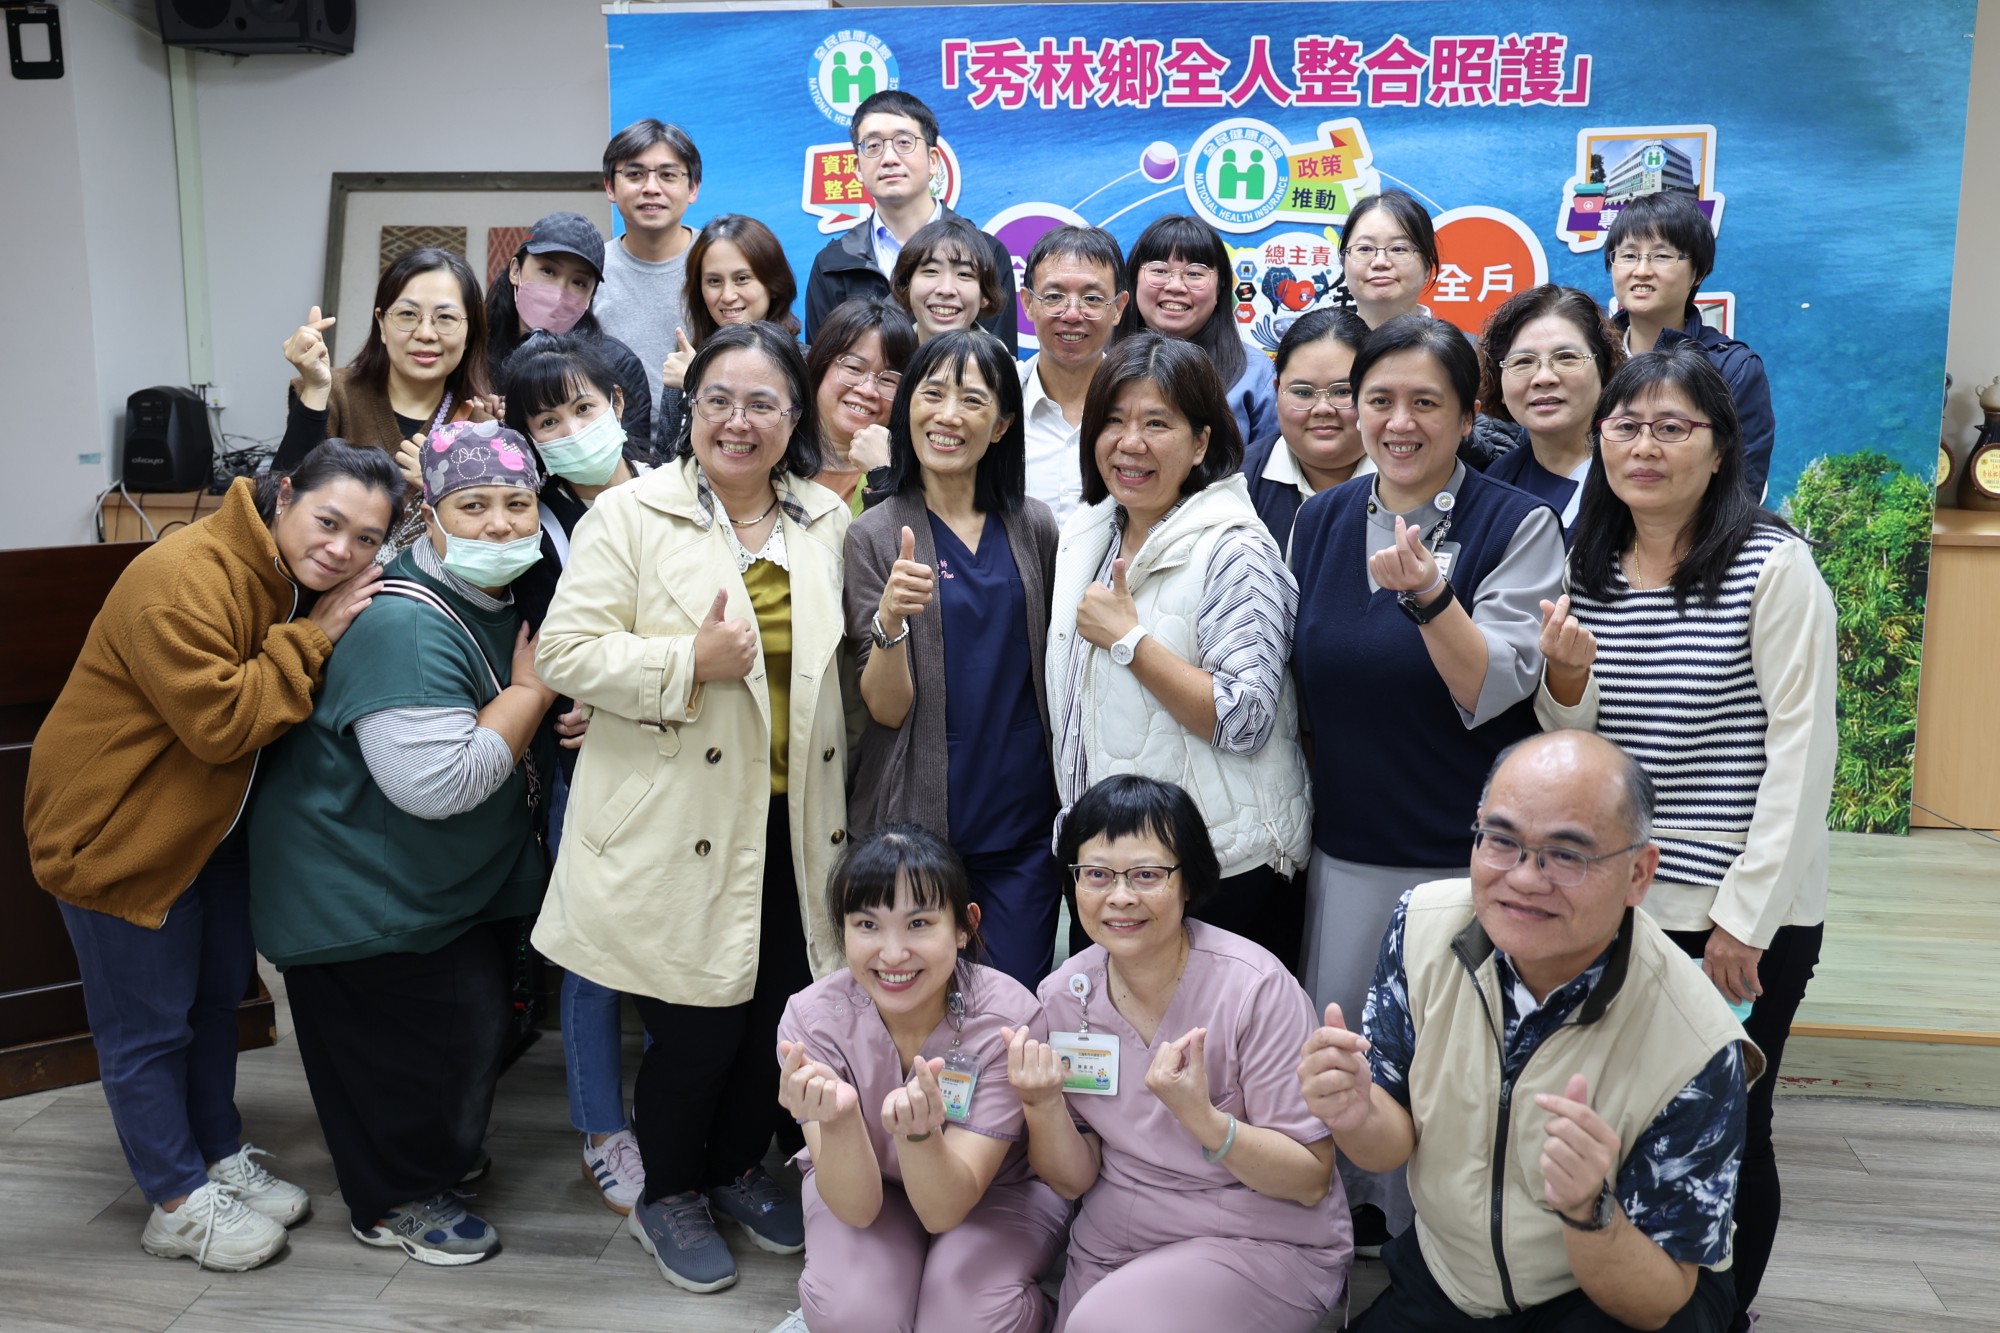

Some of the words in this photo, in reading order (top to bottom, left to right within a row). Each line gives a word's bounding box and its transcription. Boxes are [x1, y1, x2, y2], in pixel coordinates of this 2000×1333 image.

[813, 30, 892, 61] 全民健康保險
[943, 35, 1592, 108] 「秀林鄉全人整合照護」
[809, 77, 833, 119] NATIONAL
[833, 114, 853, 127] HEA
[1203, 128, 1284, 161] 全民健康保險
[1297, 154, 1343, 179] 政策
[823, 178, 863, 201] 整合
[1195, 173, 1217, 215] NATIONAL
[1219, 209, 1254, 223] HEALTH
[1254, 175, 1288, 219] INSURANCE
[1291, 187, 1336, 211] 推動
[1265, 245, 1331, 267] 總主責
[1433, 263, 1513, 303] 全戶
